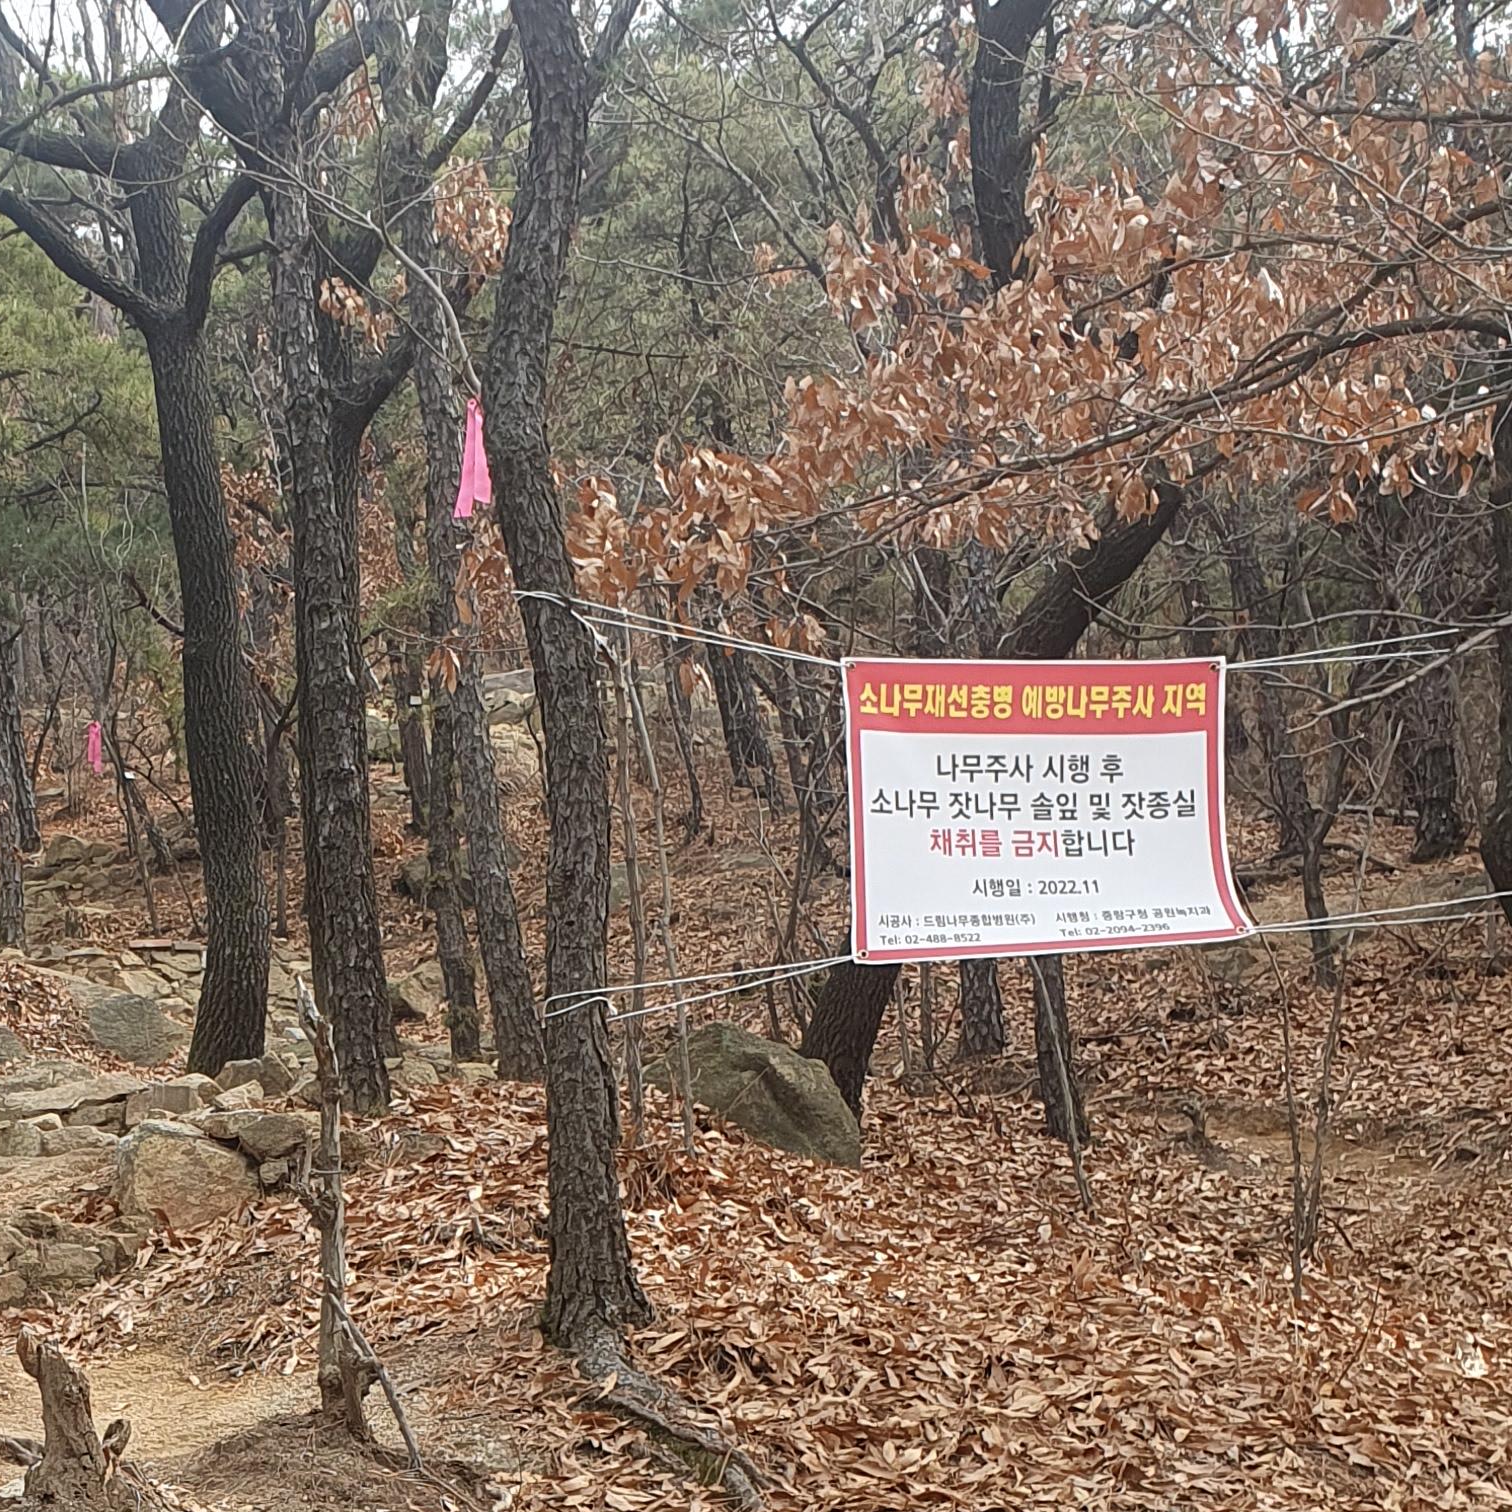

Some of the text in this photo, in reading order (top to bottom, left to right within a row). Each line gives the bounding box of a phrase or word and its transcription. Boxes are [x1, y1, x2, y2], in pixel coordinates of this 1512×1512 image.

[859, 683, 1206, 719] 소나무재선충병 예방나무주사 지역
[937, 754, 1124, 783] 나무주사 시행 후
[871, 789, 1196, 821] 소나무 잣나무 솔잎 및 잣종실
[930, 828, 1135, 857] 채취를 금지합니다
[973, 879, 1021, 897] 시행일
[1038, 880, 1099, 895] 2022.11
[879, 914, 912, 928] 시공사
[1059, 923, 1170, 937] Tel: 02-2094-2396
[880, 933, 982, 945] Tel: 02-488-8522
